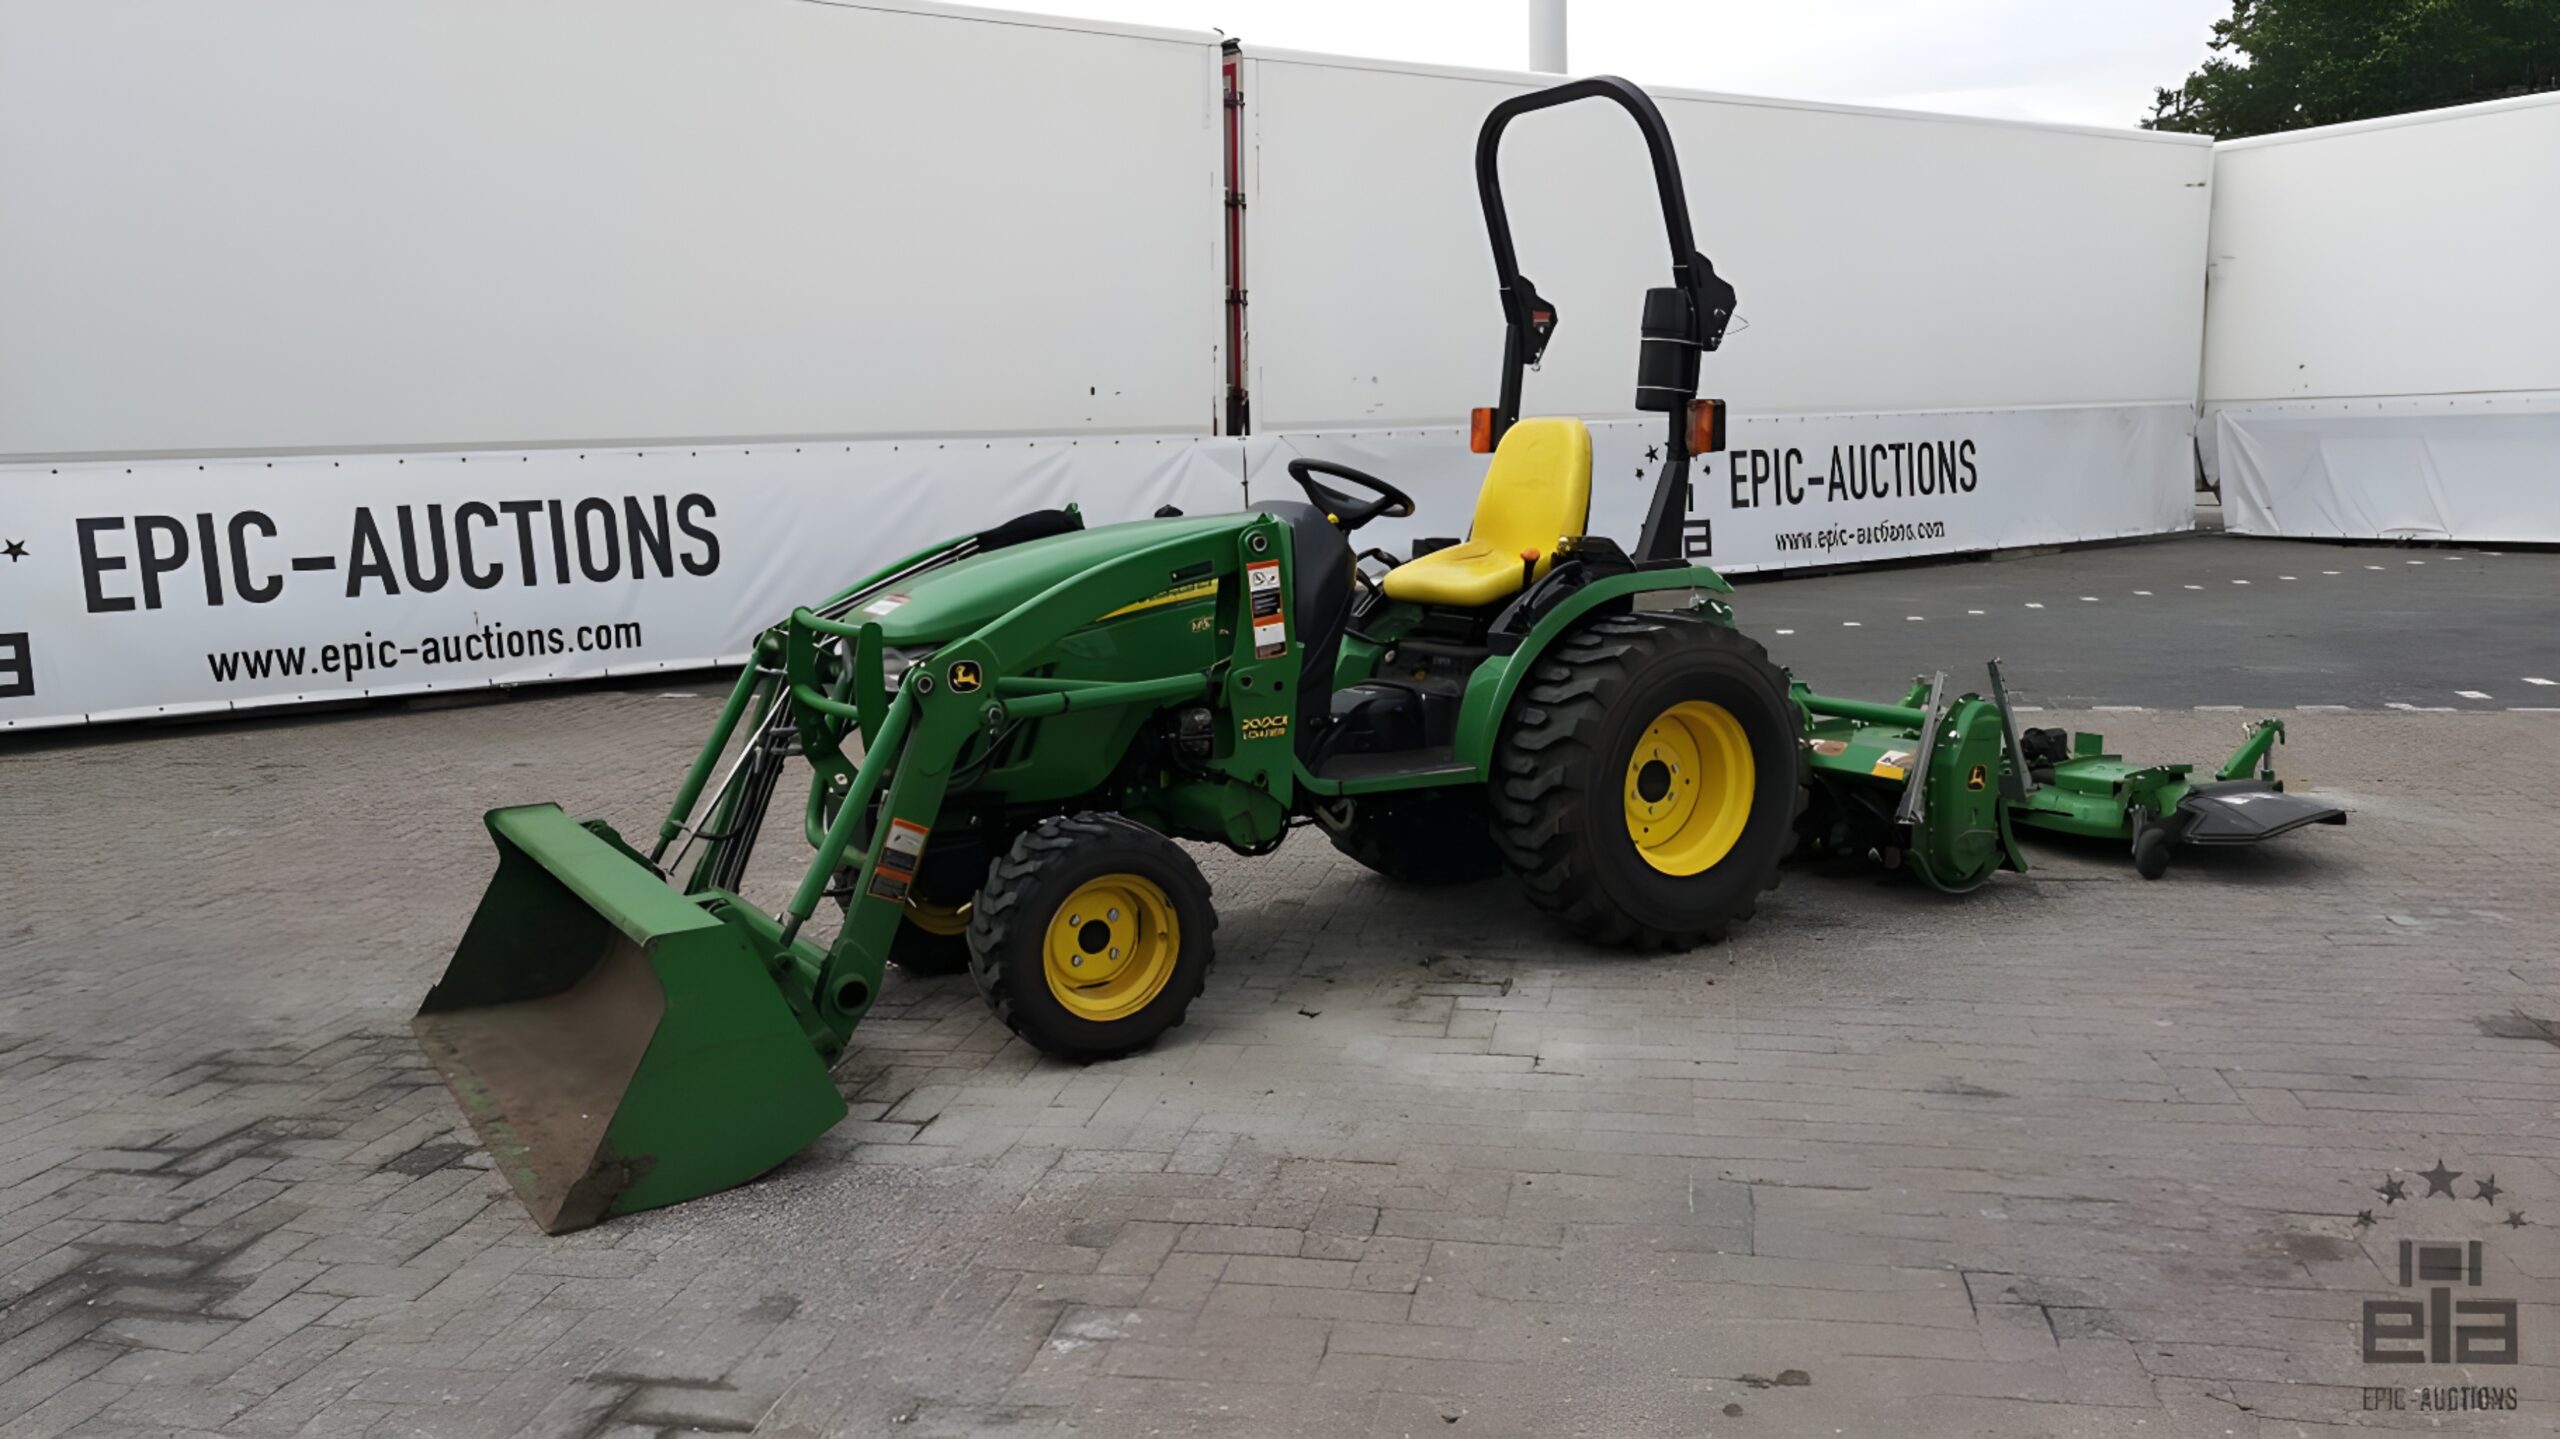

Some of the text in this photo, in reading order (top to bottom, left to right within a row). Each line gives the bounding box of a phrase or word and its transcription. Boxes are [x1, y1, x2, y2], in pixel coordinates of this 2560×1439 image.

[1729, 439, 1977, 509] EPIC-AUCTIONS
[76, 493, 721, 613] EPIC-AUCTIONS
[207, 620, 643, 682] www.epic-auctions.com
